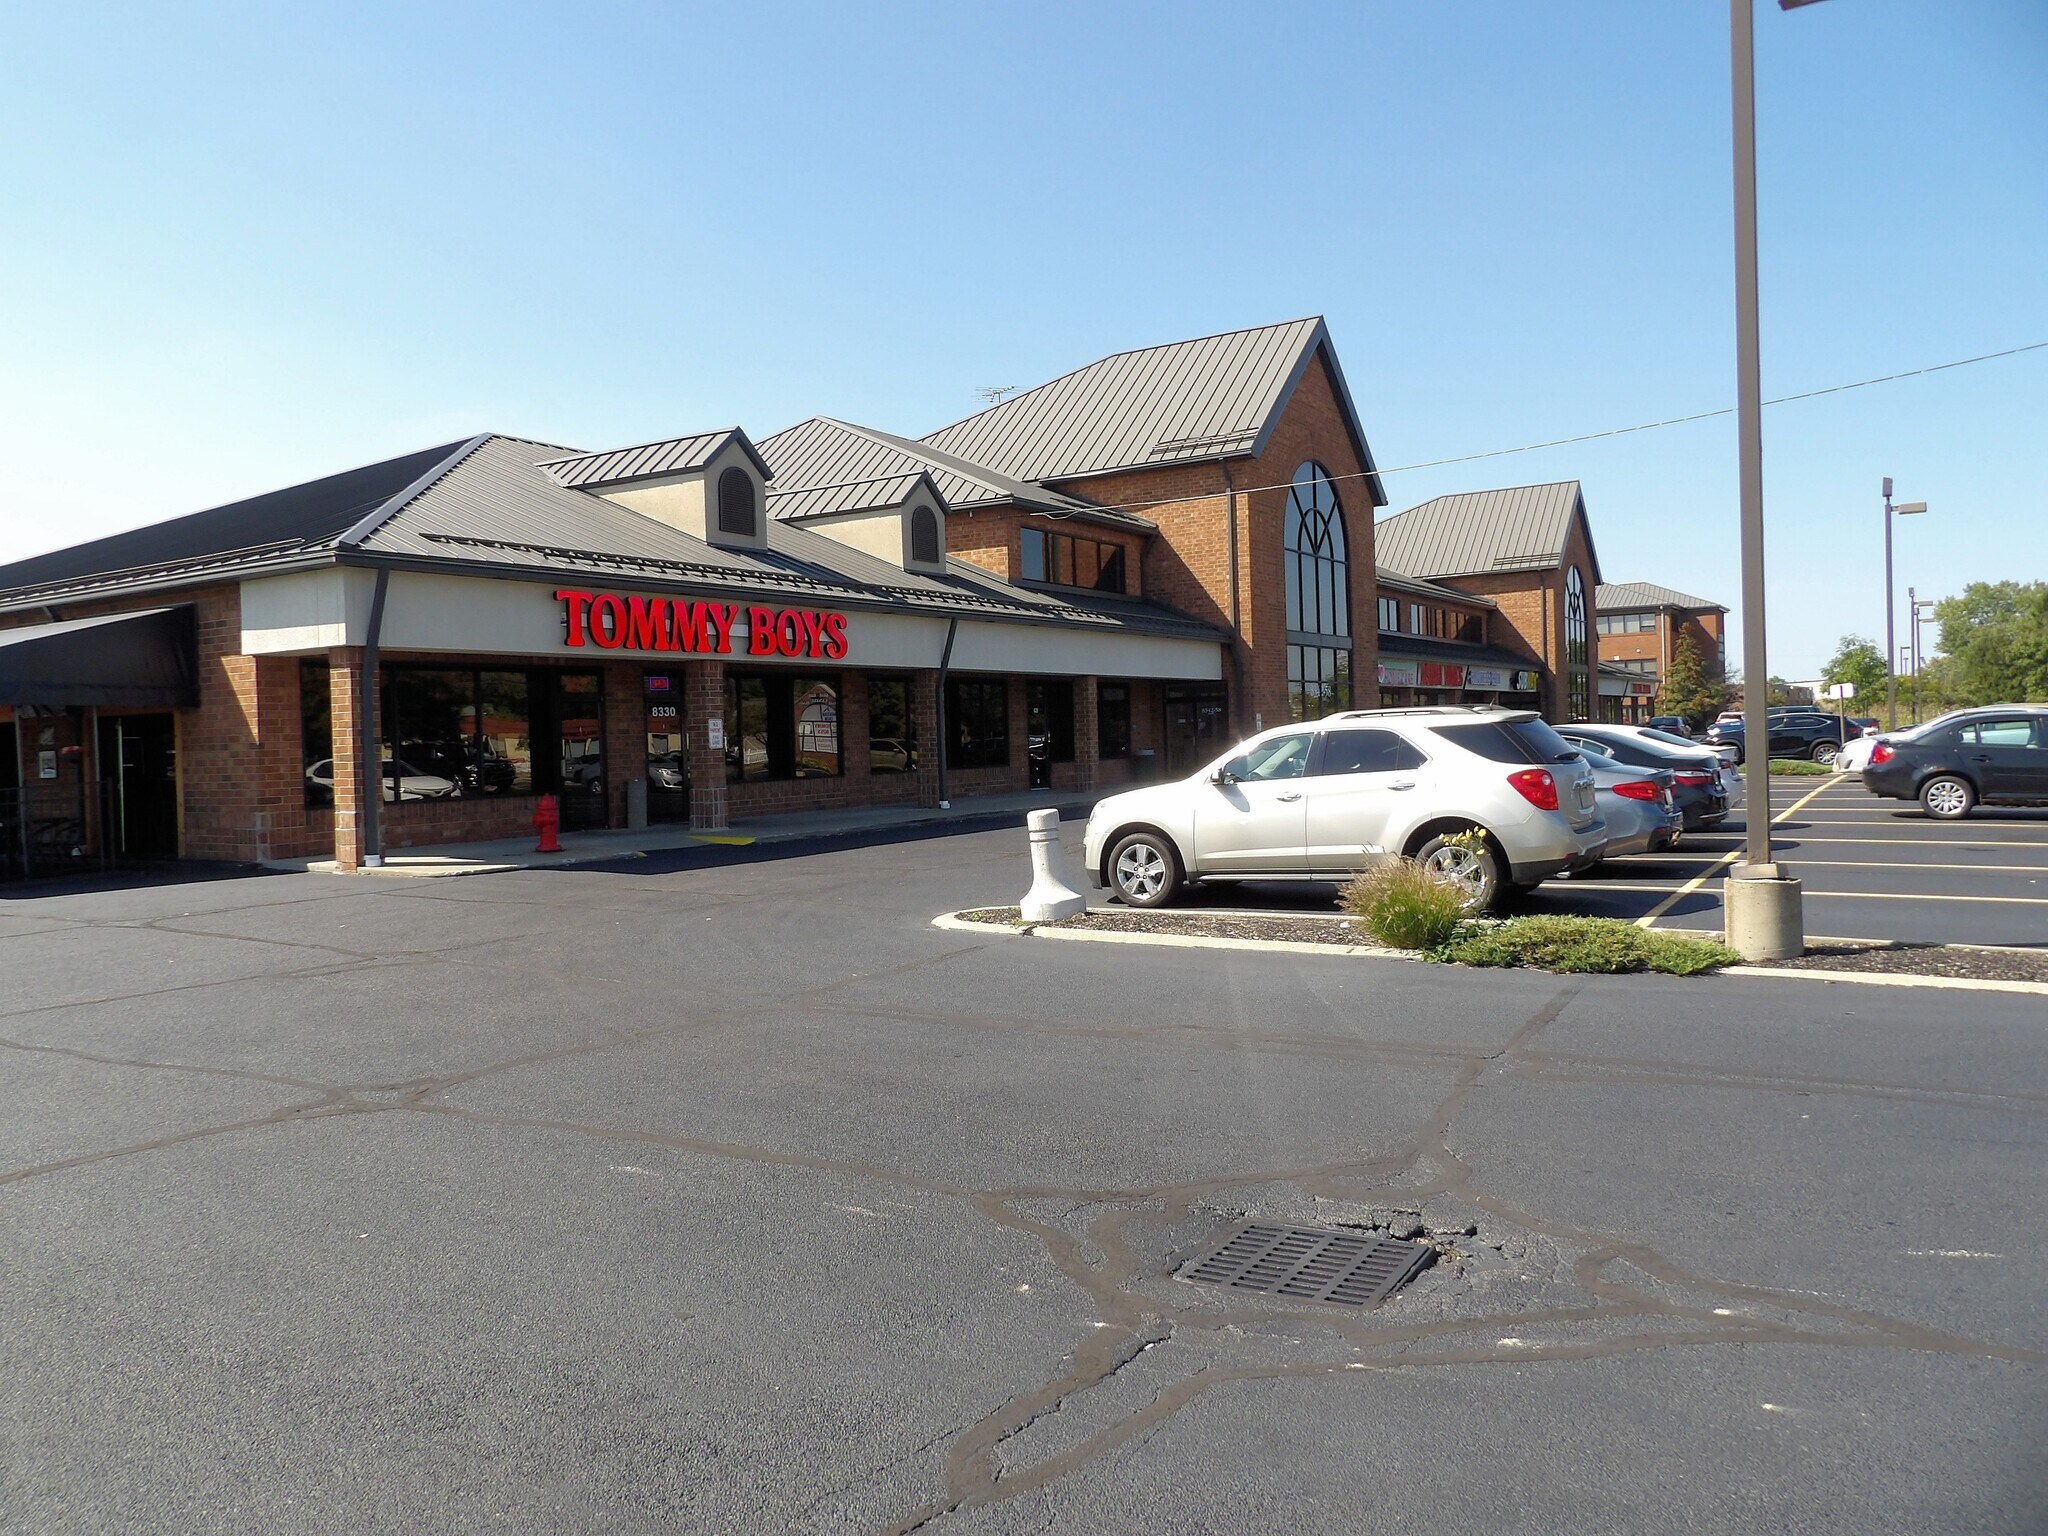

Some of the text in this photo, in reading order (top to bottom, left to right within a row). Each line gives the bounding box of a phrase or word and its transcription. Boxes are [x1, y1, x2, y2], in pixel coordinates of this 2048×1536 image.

[554, 589, 848, 659] TOMMY BOYS
[652, 706, 676, 717] 8330
